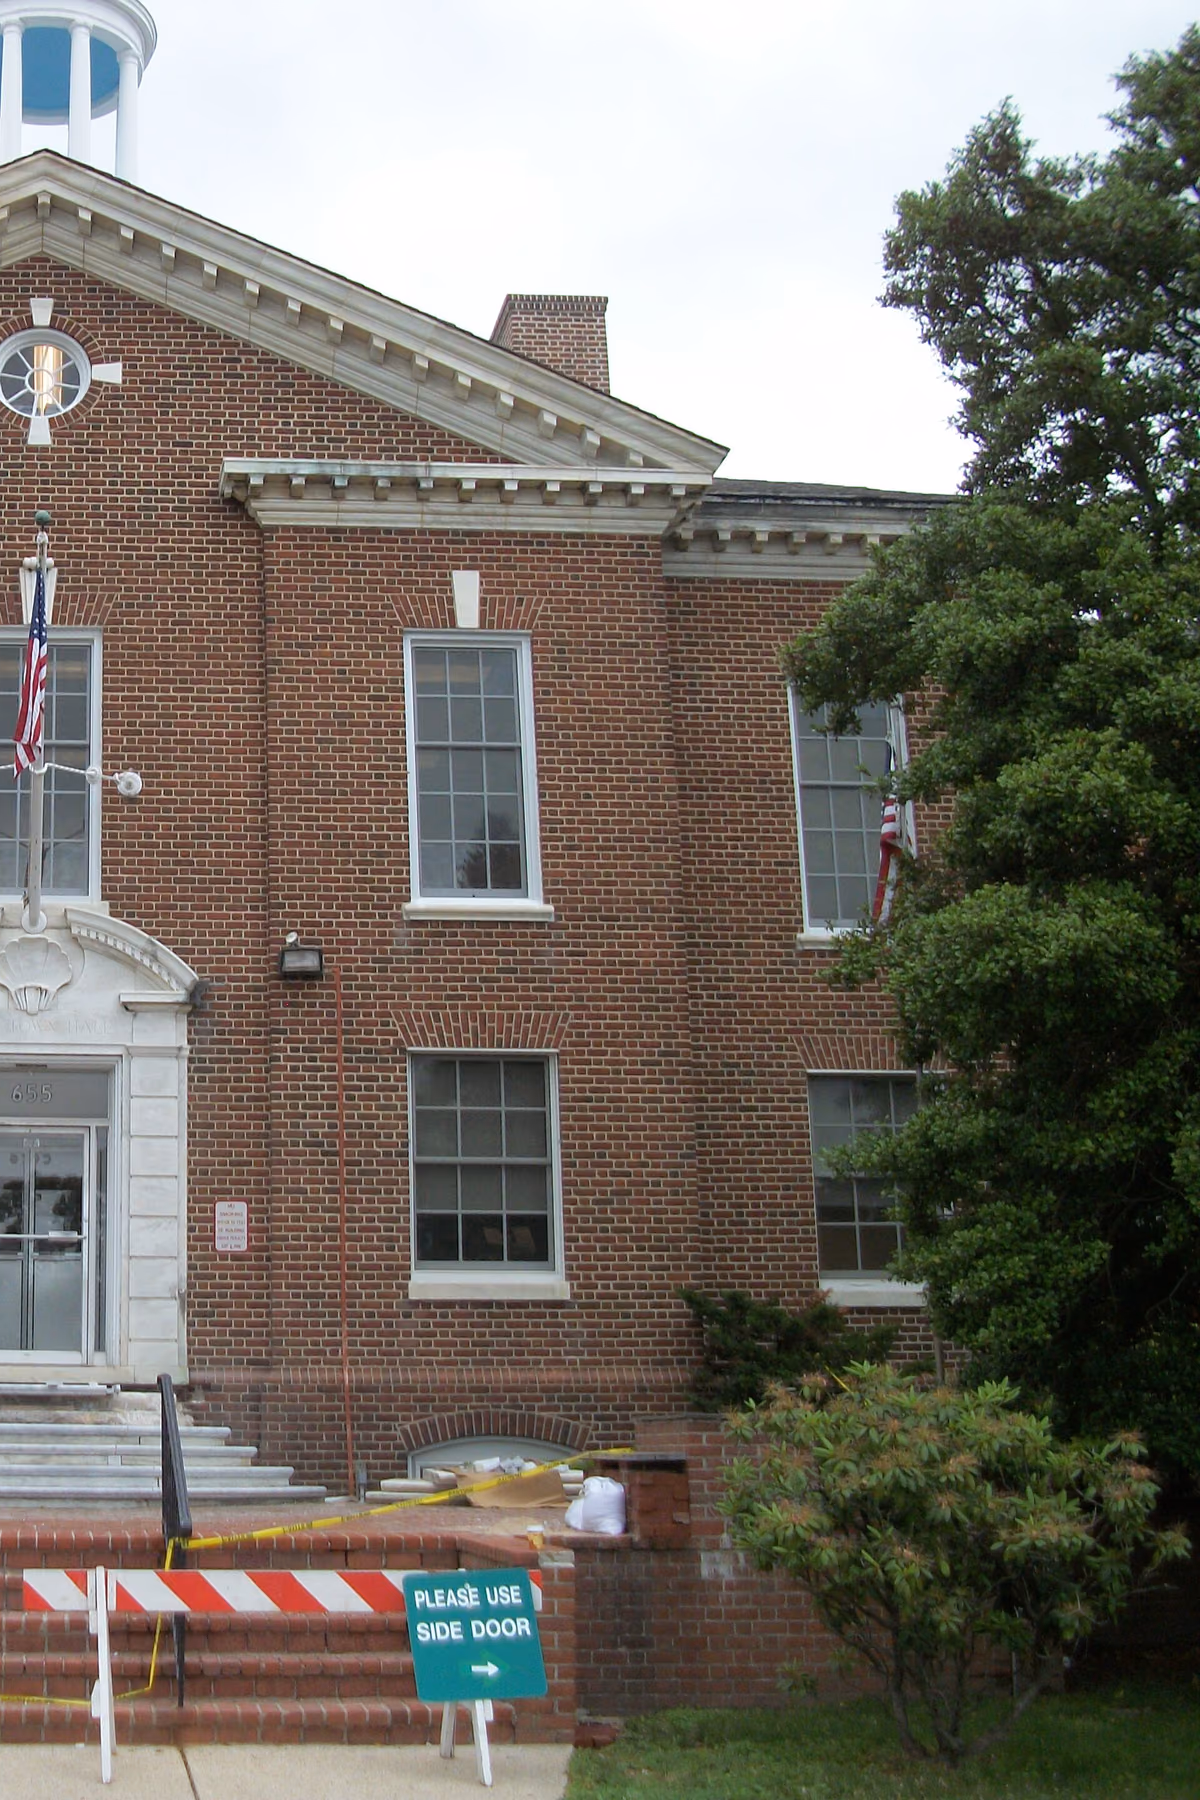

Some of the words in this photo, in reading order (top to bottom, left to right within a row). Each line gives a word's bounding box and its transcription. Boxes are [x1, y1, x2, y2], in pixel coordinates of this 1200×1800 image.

[9, 1018, 57, 1034] TOWN
[11, 1083, 53, 1103] 655
[414, 1586, 480, 1609] PLEASE
[486, 1585, 522, 1605] USE
[416, 1620, 464, 1642] SIDE
[471, 1617, 531, 1639] DOOR
